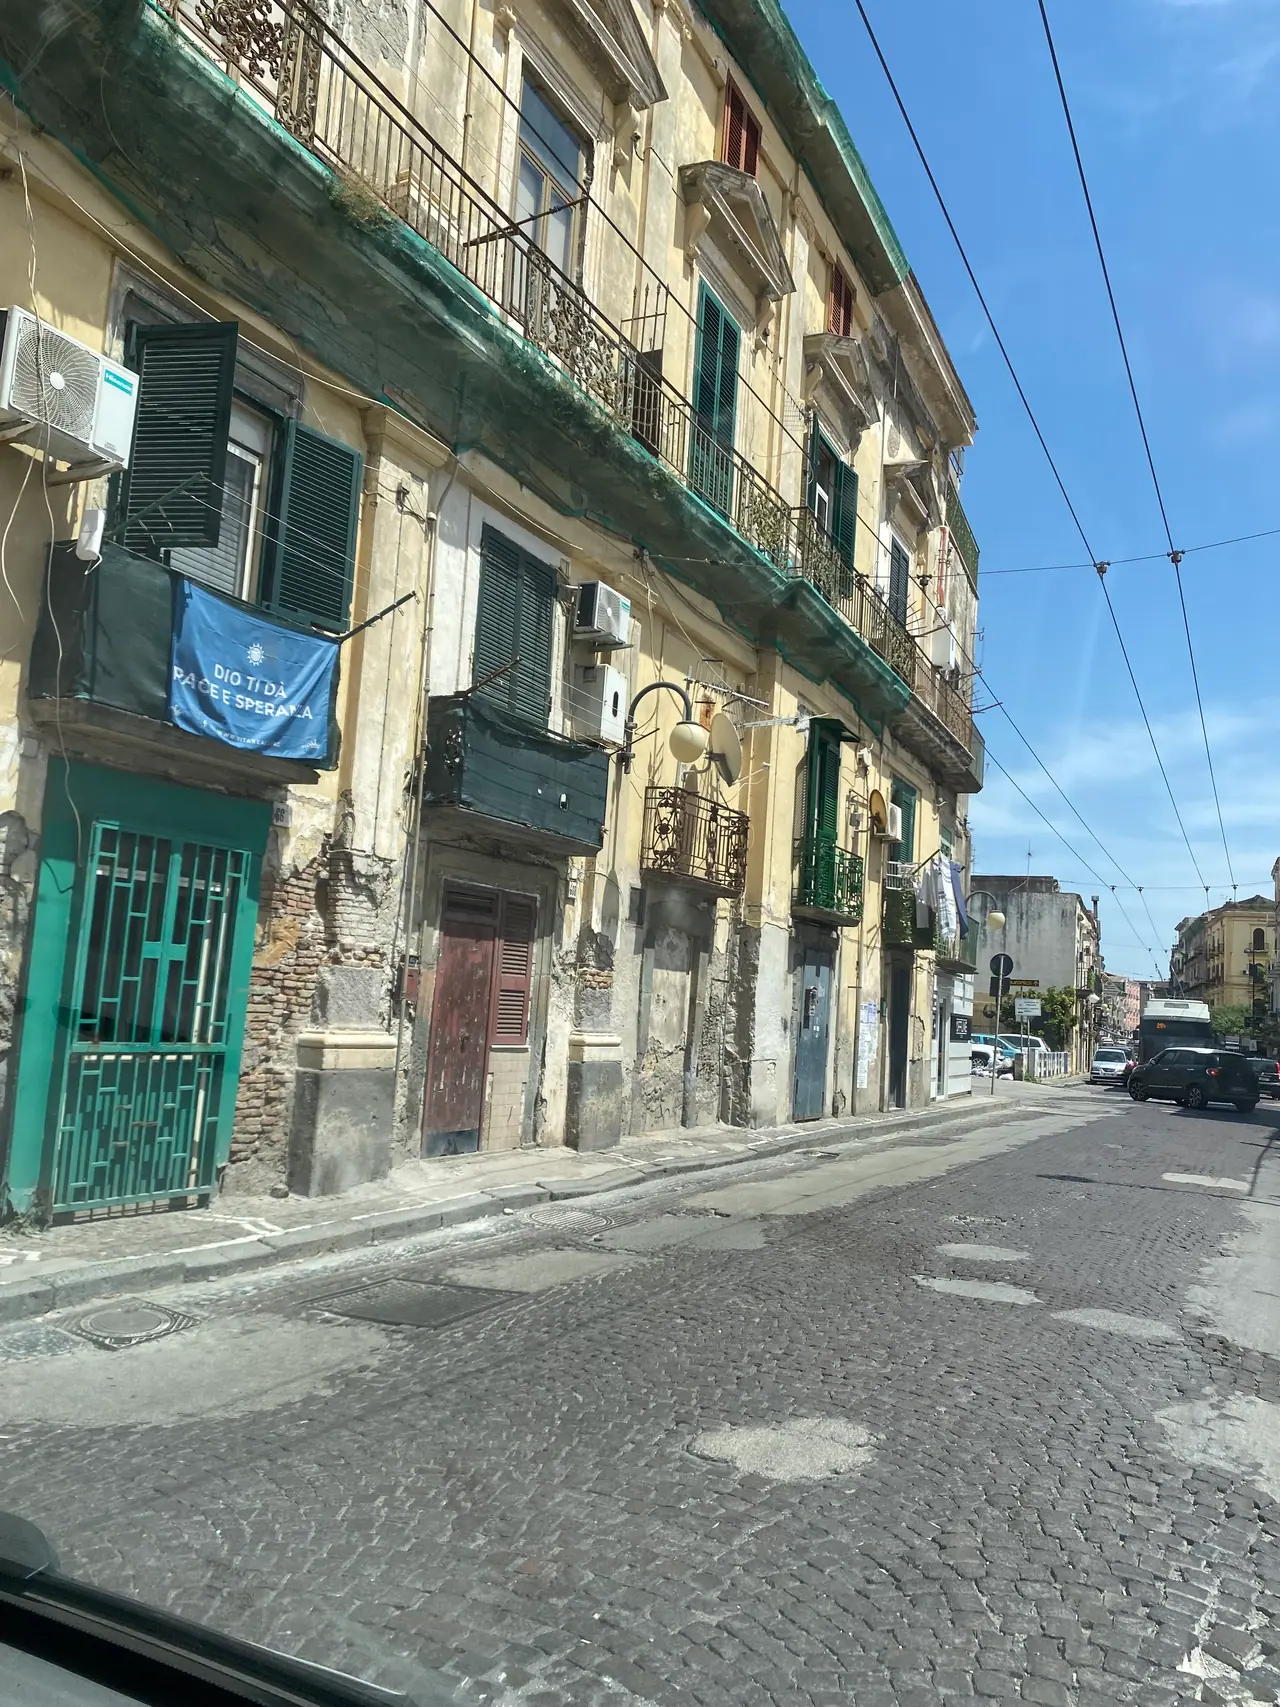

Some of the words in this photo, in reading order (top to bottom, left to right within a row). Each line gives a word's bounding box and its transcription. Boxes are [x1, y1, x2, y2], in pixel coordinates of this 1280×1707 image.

[173, 665, 219, 699] PACE
[222, 689, 231, 705] E
[214, 663, 241, 686] DIO
[246, 676, 260, 693] TI
[263, 681, 287, 699] DÀ
